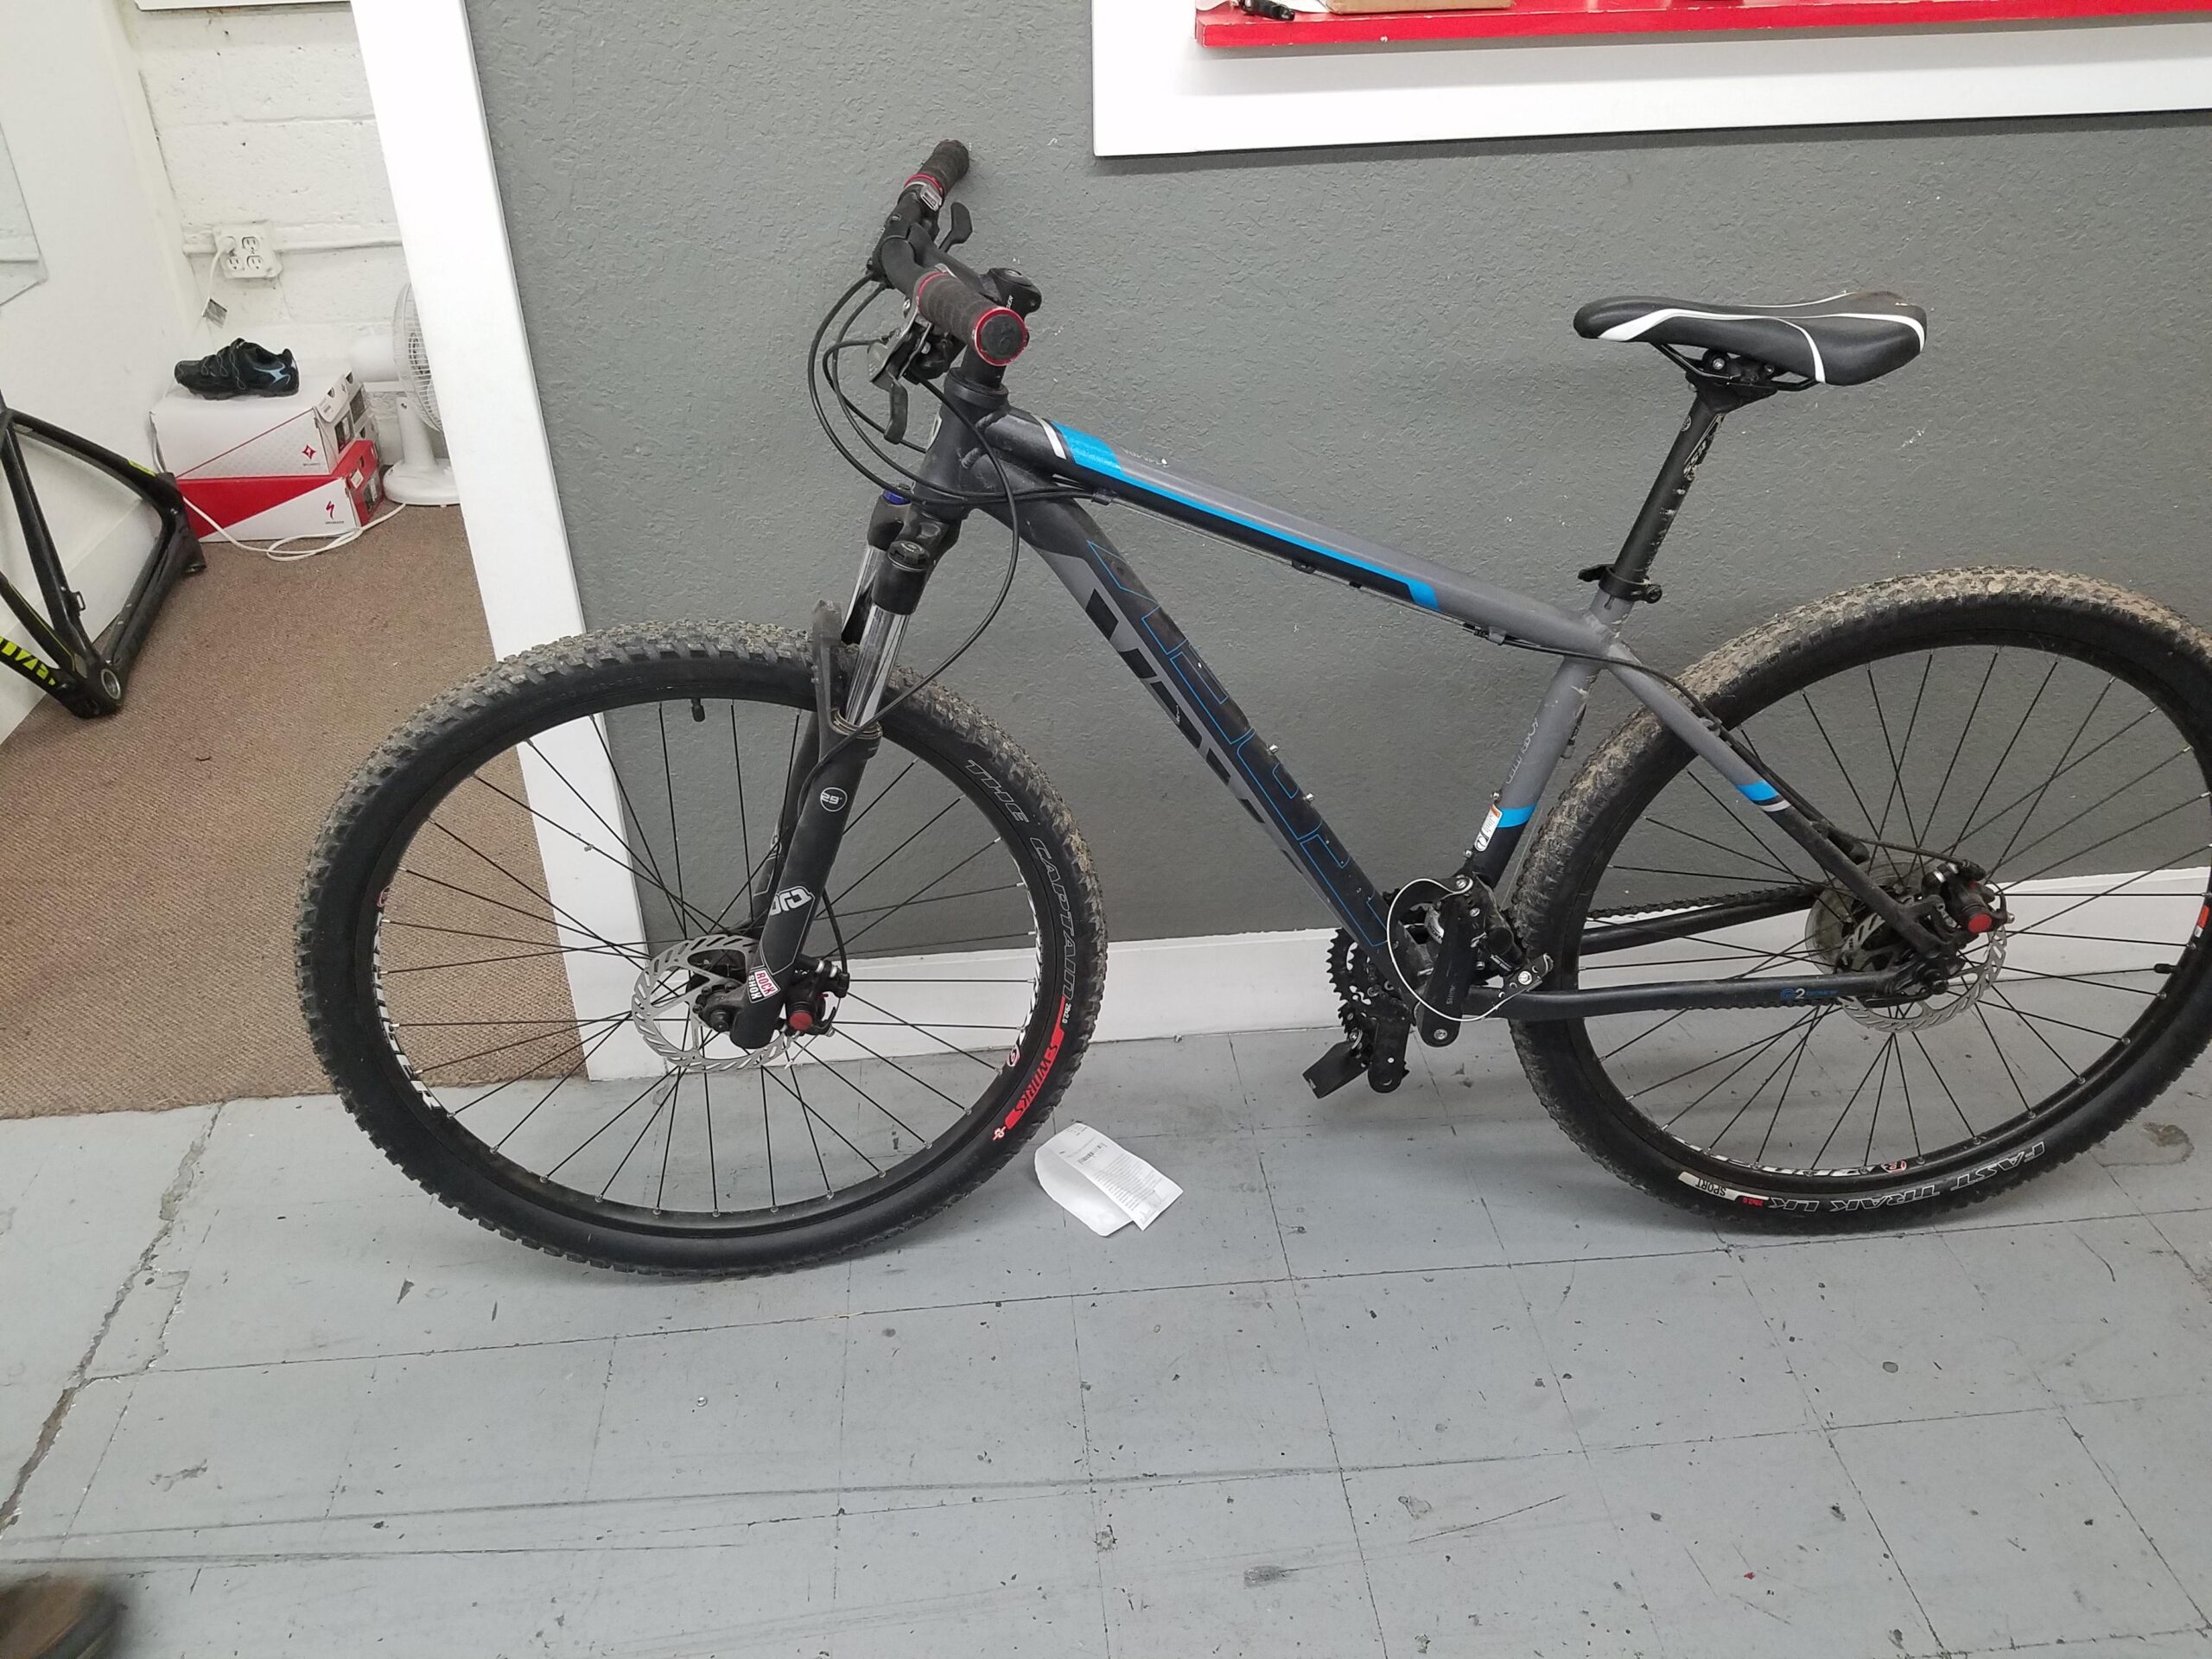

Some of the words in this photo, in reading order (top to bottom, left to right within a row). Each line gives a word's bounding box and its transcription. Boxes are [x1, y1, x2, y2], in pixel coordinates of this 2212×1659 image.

[964, 759, 1030, 823] THE
[1029, 836, 1077, 1001] CAPTAIN
[748, 974, 763, 1001] SHOX
[756, 972, 776, 995] ROCK
[1014, 1043, 1058, 1114] S-WORKS
[1949, 1141, 2046, 1192] FAST
[1695, 1178, 1727, 1197] SPORT
[1829, 1184, 1941, 1212] TRAK
[1767, 1196, 1821, 1212] LK
